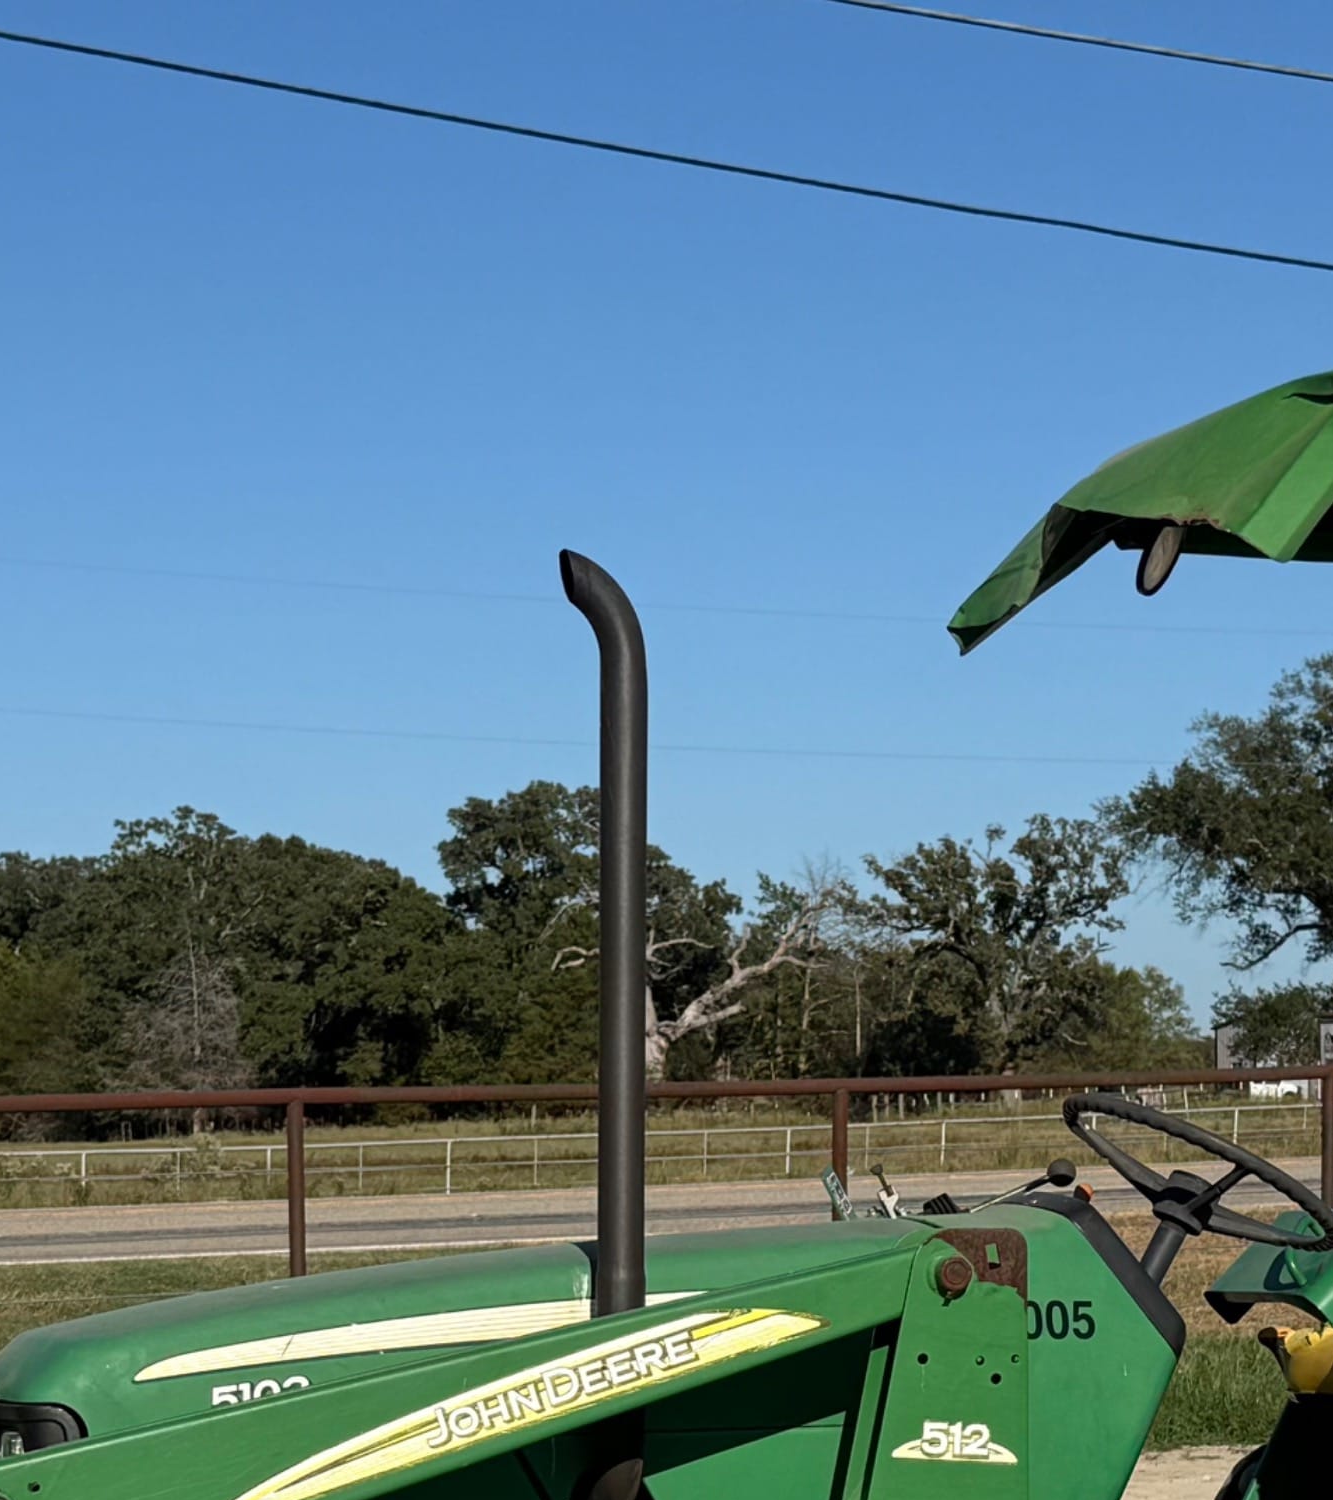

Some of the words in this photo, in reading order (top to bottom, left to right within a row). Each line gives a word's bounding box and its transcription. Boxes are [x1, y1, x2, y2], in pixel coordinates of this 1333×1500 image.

[1027, 1299, 1096, 1340] 005
[427, 1381, 544, 1448] JOHN
[541, 1329, 699, 1407] DEERE
[920, 1420, 991, 1459] 512
